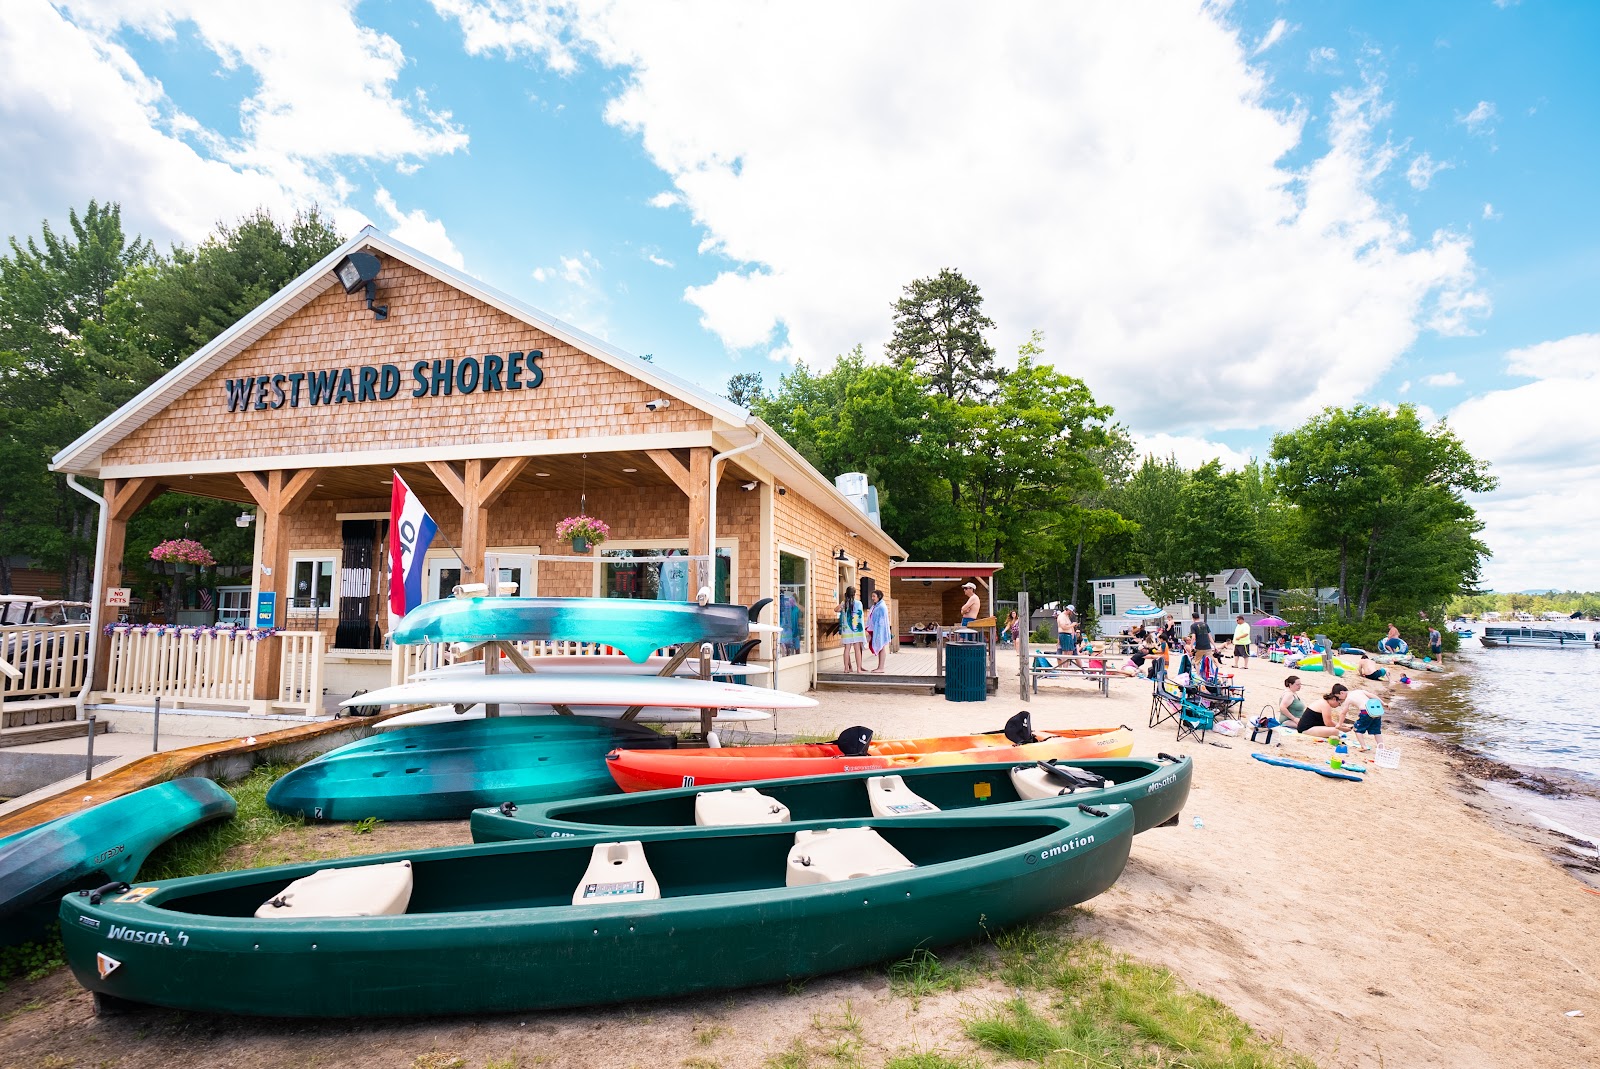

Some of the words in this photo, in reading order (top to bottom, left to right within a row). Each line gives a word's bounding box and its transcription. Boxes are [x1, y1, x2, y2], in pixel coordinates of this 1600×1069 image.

[226, 364, 400, 412] WESTWARD
[412, 349, 543, 398] SHORES
[1147, 773, 1177, 793] Wasatch
[1040, 834, 1095, 860] emotion
